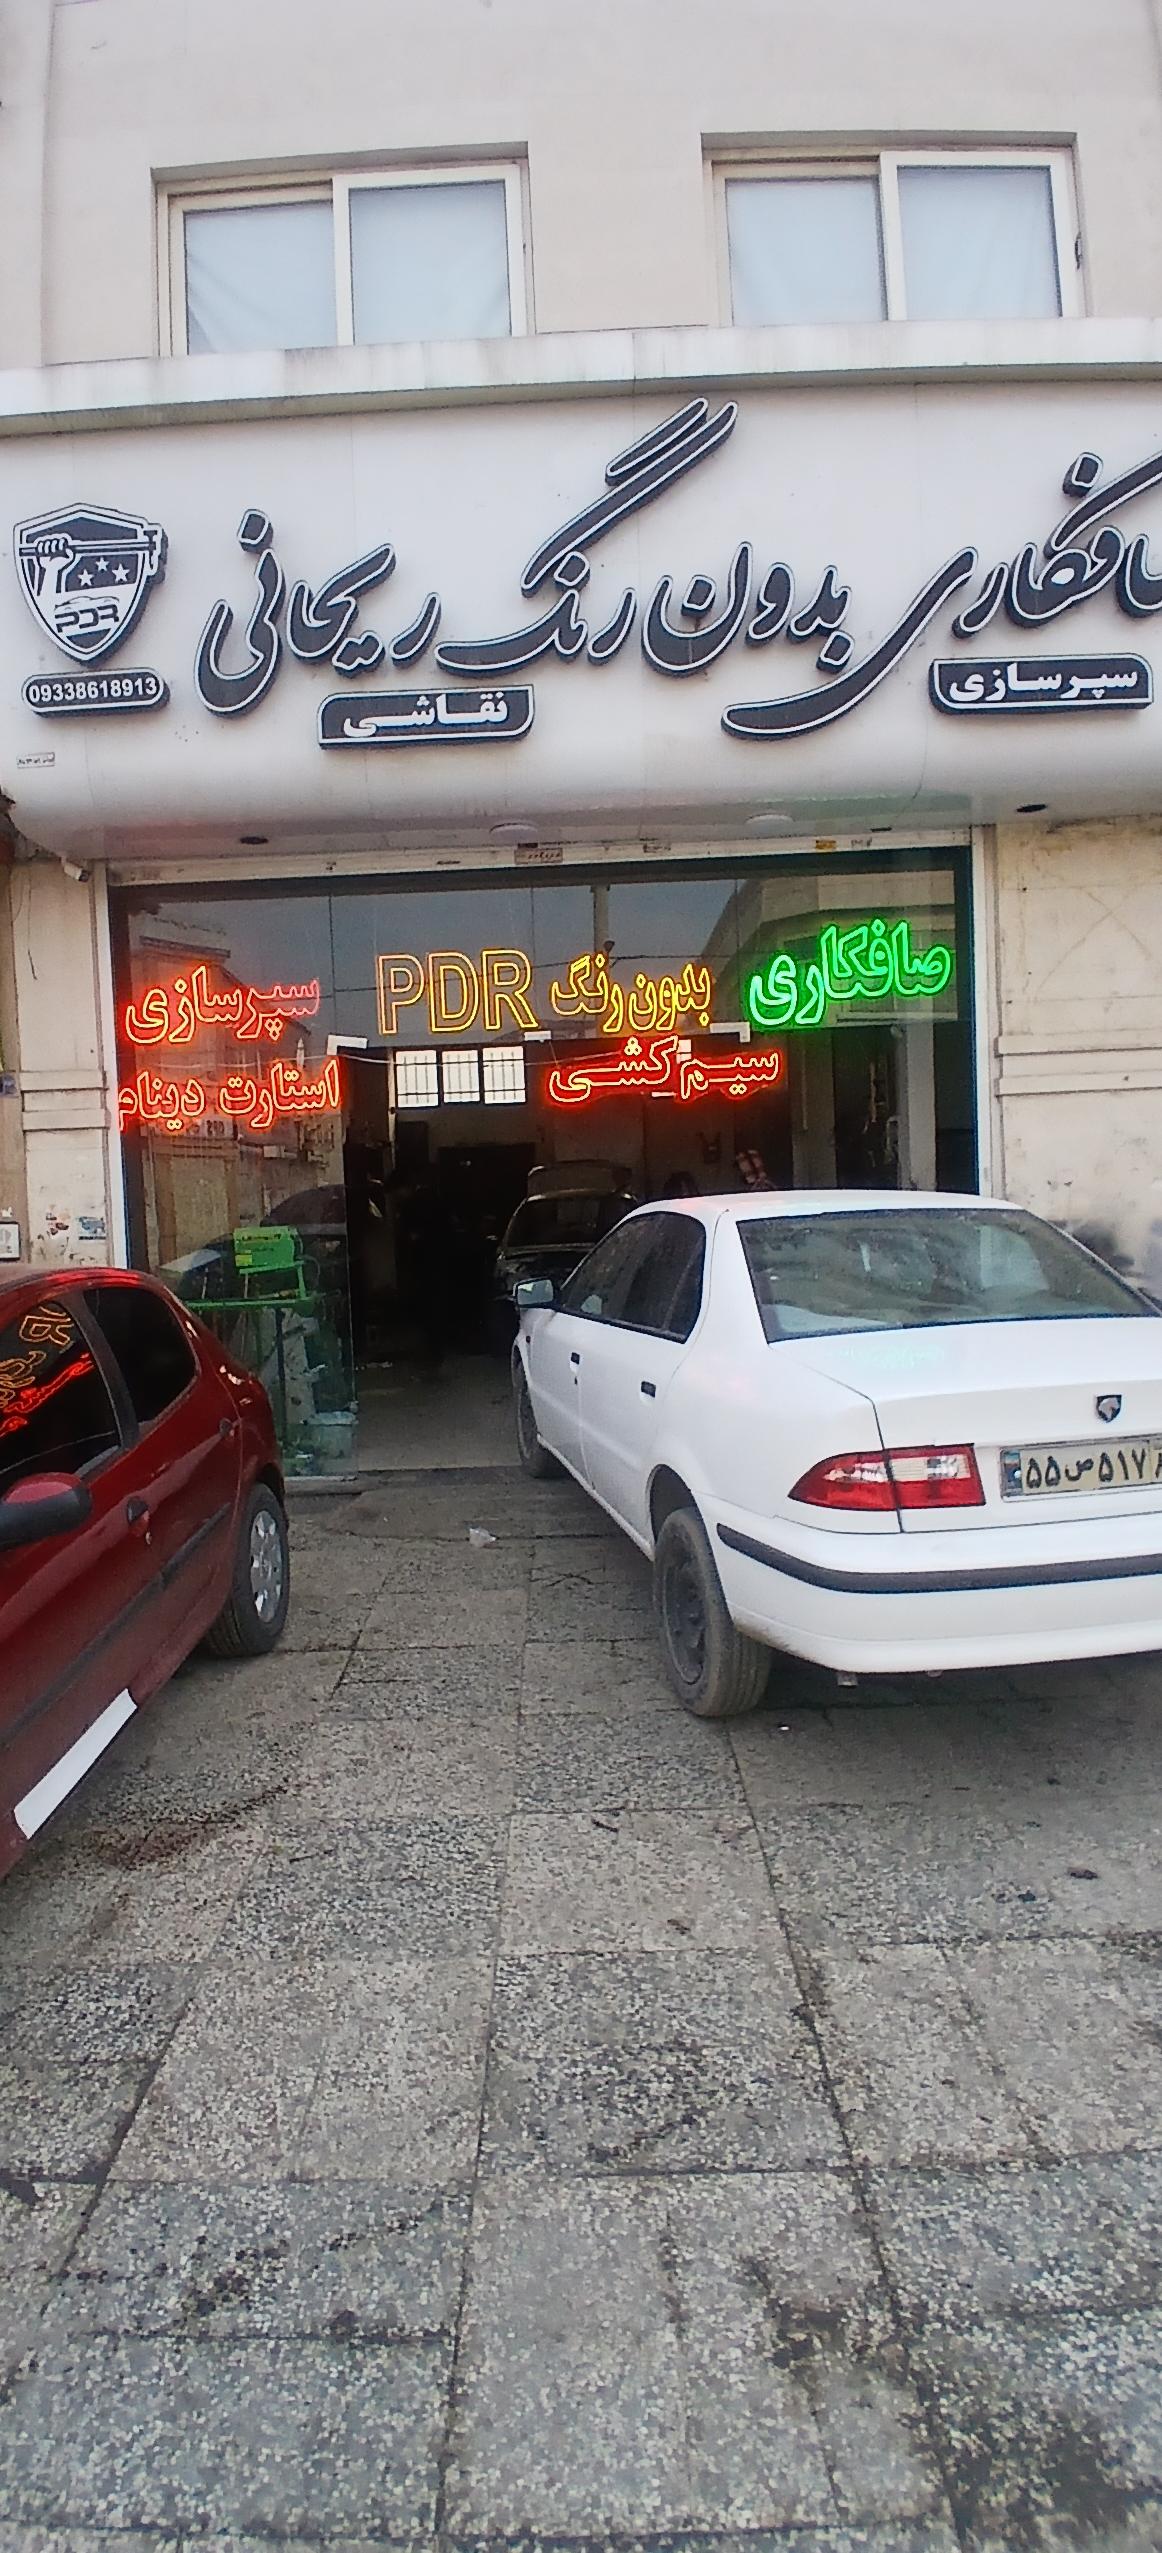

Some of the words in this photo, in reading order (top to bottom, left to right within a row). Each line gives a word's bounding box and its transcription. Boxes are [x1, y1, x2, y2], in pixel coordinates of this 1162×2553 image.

[433, 397, 739, 672] رنگ
[54, 603, 120, 633] PDR
[196, 508, 443, 714] ریحانی
[643, 542, 855, 678] بدون
[721, 450, 1162, 742] افکاری
[28, 677, 157, 703] 09338618913
[342, 690, 509, 738] نقاشی
[376, 949, 538, 1036] PDR
[551, 953, 622, 1033] رنگ
[627, 962, 711, 1030] بدون
[749, 919, 951, 1026] صافکاری
[117, 1070, 206, 1132] دینام
[219, 1056, 341, 1129] استارت
